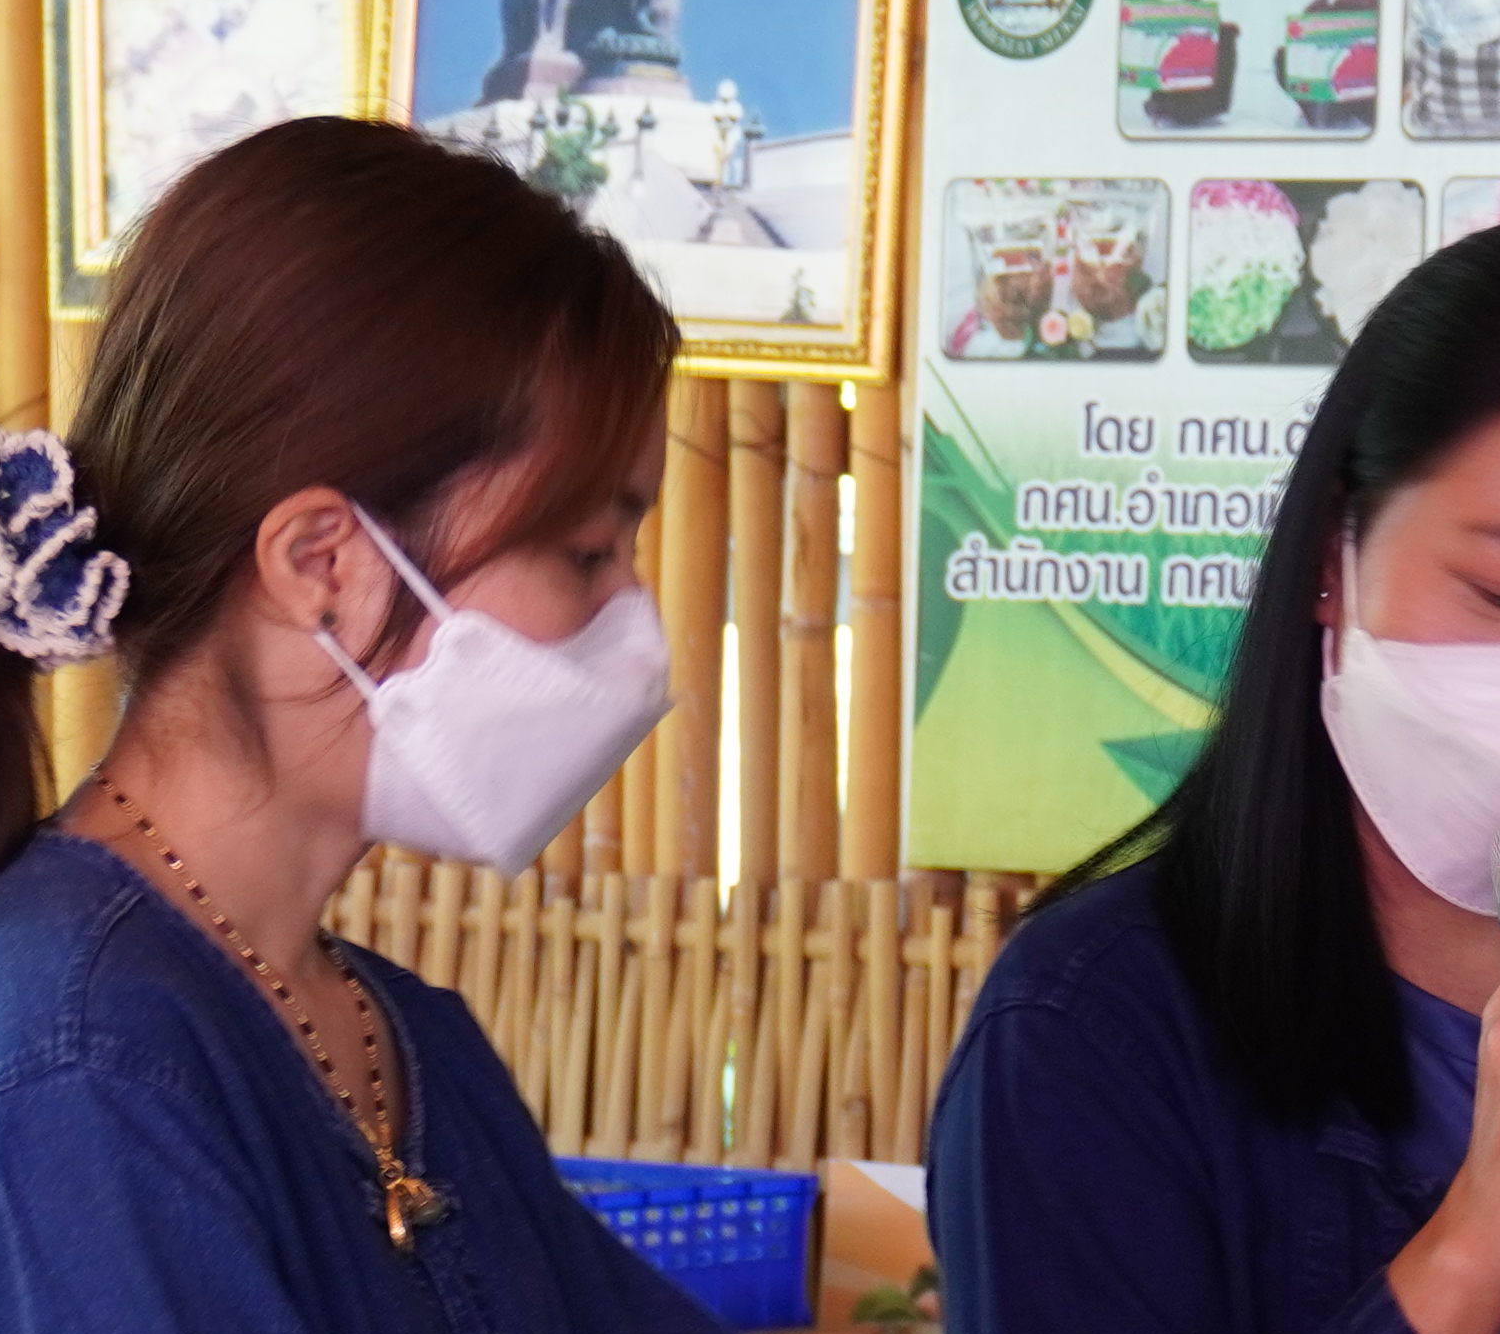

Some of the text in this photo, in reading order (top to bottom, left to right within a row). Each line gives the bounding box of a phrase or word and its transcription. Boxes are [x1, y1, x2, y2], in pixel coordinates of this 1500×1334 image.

[1084, 401, 1154, 454] โดย
[951, 539, 1143, 597] สำนักงาน
